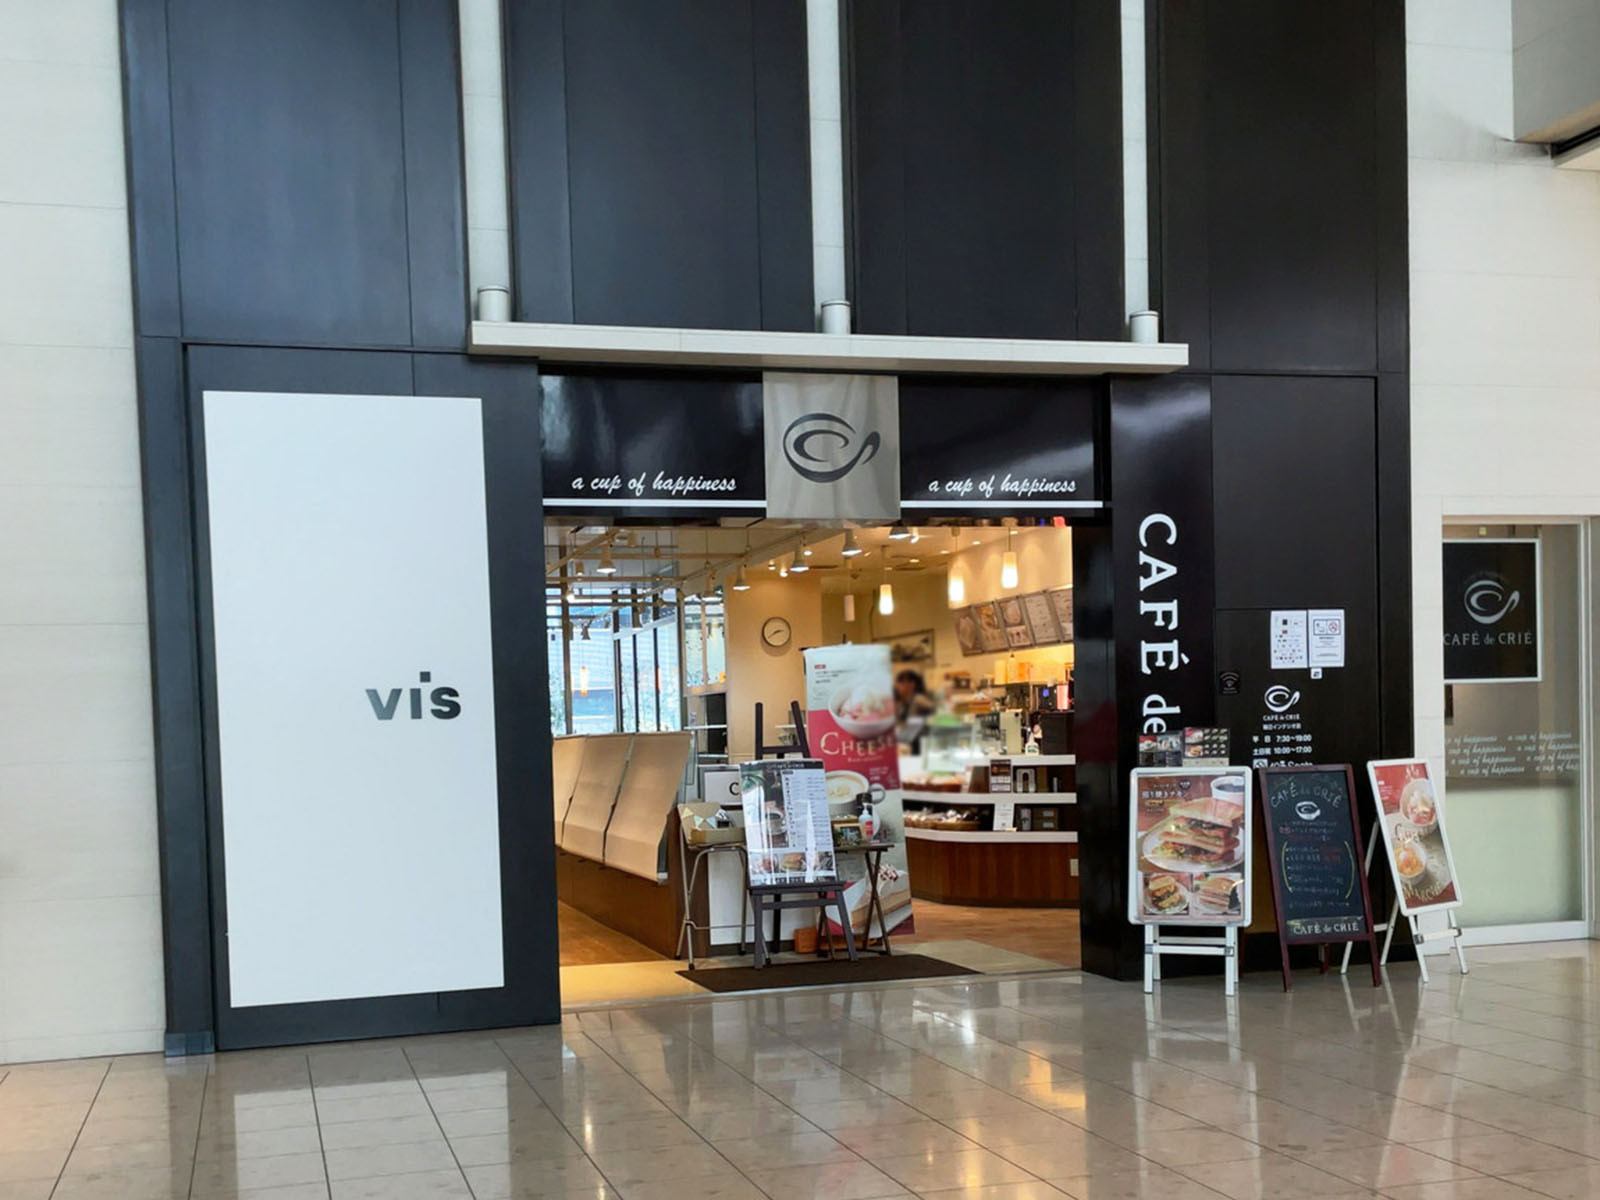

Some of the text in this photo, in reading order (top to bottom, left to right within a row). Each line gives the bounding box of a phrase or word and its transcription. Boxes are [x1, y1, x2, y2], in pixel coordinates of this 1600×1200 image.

[571, 471, 736, 496] a cup of happiness
[928, 473, 1077, 498] a cup of happiness
[1138, 513, 1190, 675] CAFÉ
[1443, 630, 1480, 646] CAFÉ
[365, 671, 461, 720] vis
[1142, 694, 1181, 734] de
